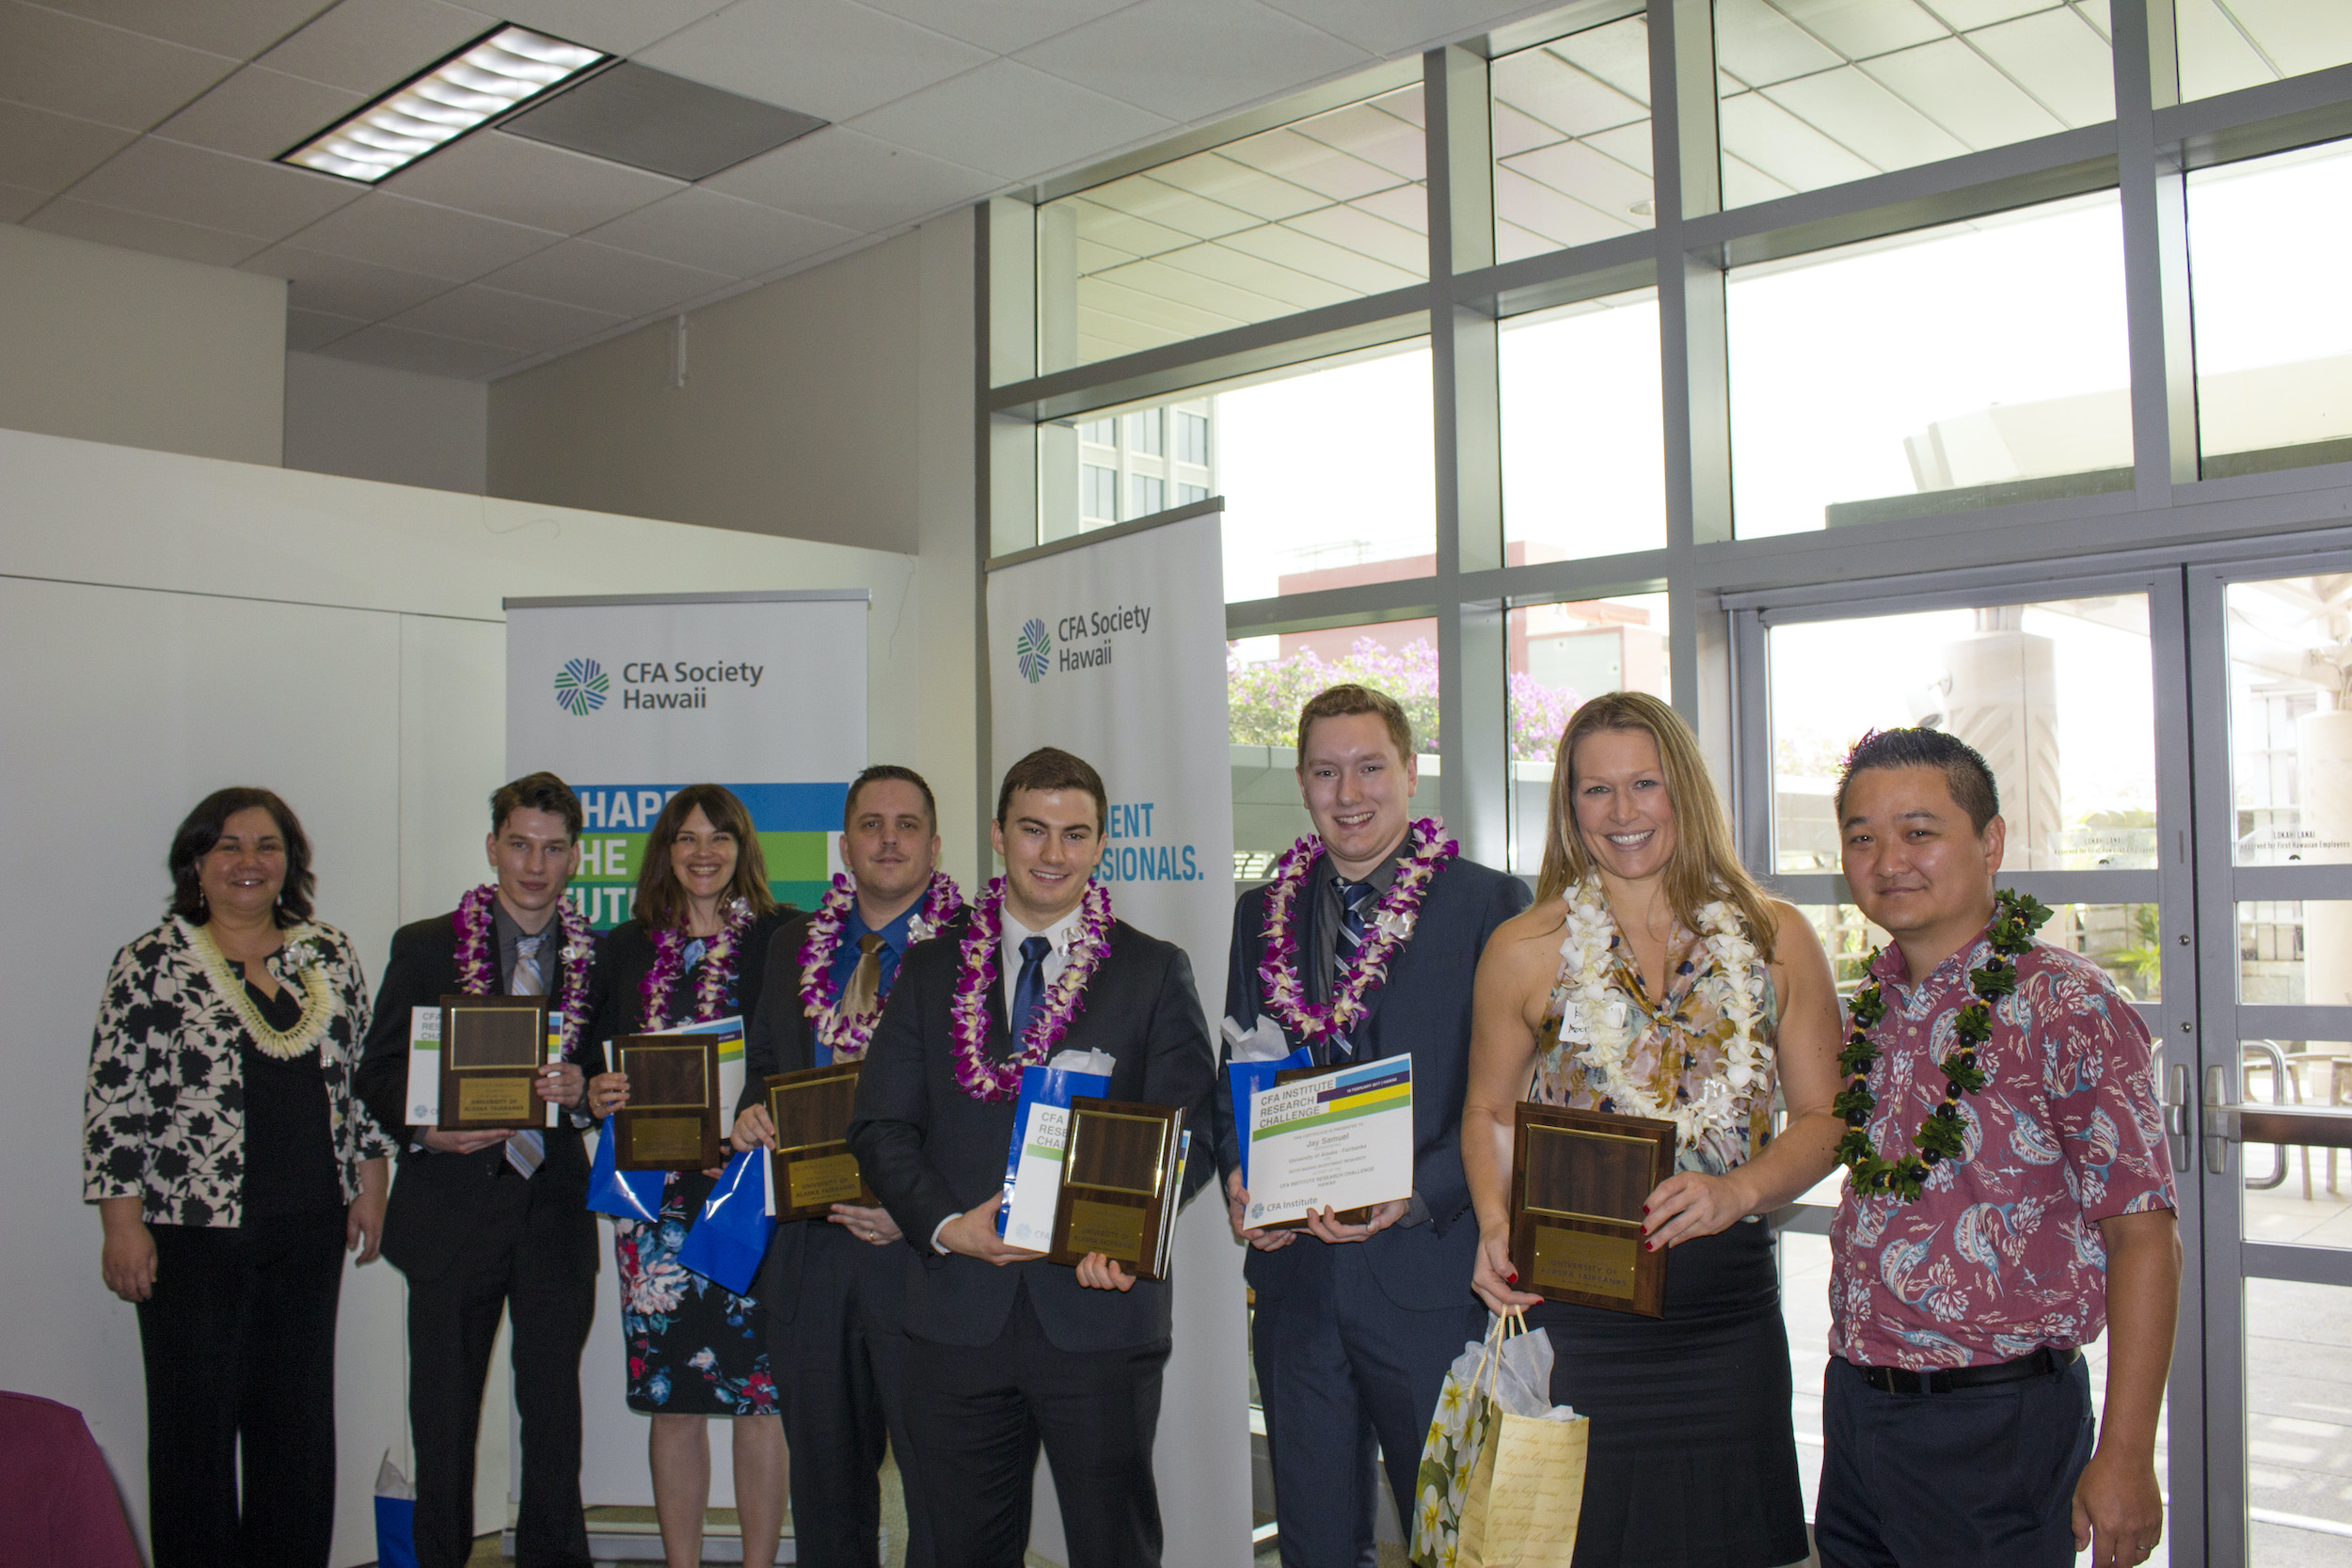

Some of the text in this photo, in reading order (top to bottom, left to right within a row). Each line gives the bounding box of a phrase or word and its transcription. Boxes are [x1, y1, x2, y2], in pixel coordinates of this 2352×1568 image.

[1058, 605, 1151, 641] CFA Society
[1059, 639, 1112, 673] Hawaii
[623, 660, 764, 688] CFA Society
[624, 687, 707, 709] Hawaii
[580, 791, 677, 828] HAP
[577, 839, 628, 875] HE
[1261, 1080, 1334, 1106] CFA INSTITUTE
[1041, 1112, 1063, 1124] CFA
[1259, 1106, 1320, 1128] CHALLENGE
[1261, 1096, 1314, 1117] RESEARCH
[1322, 1132, 1349, 1144] Samuel
[1266, 1197, 1318, 1212] CFA Institute
